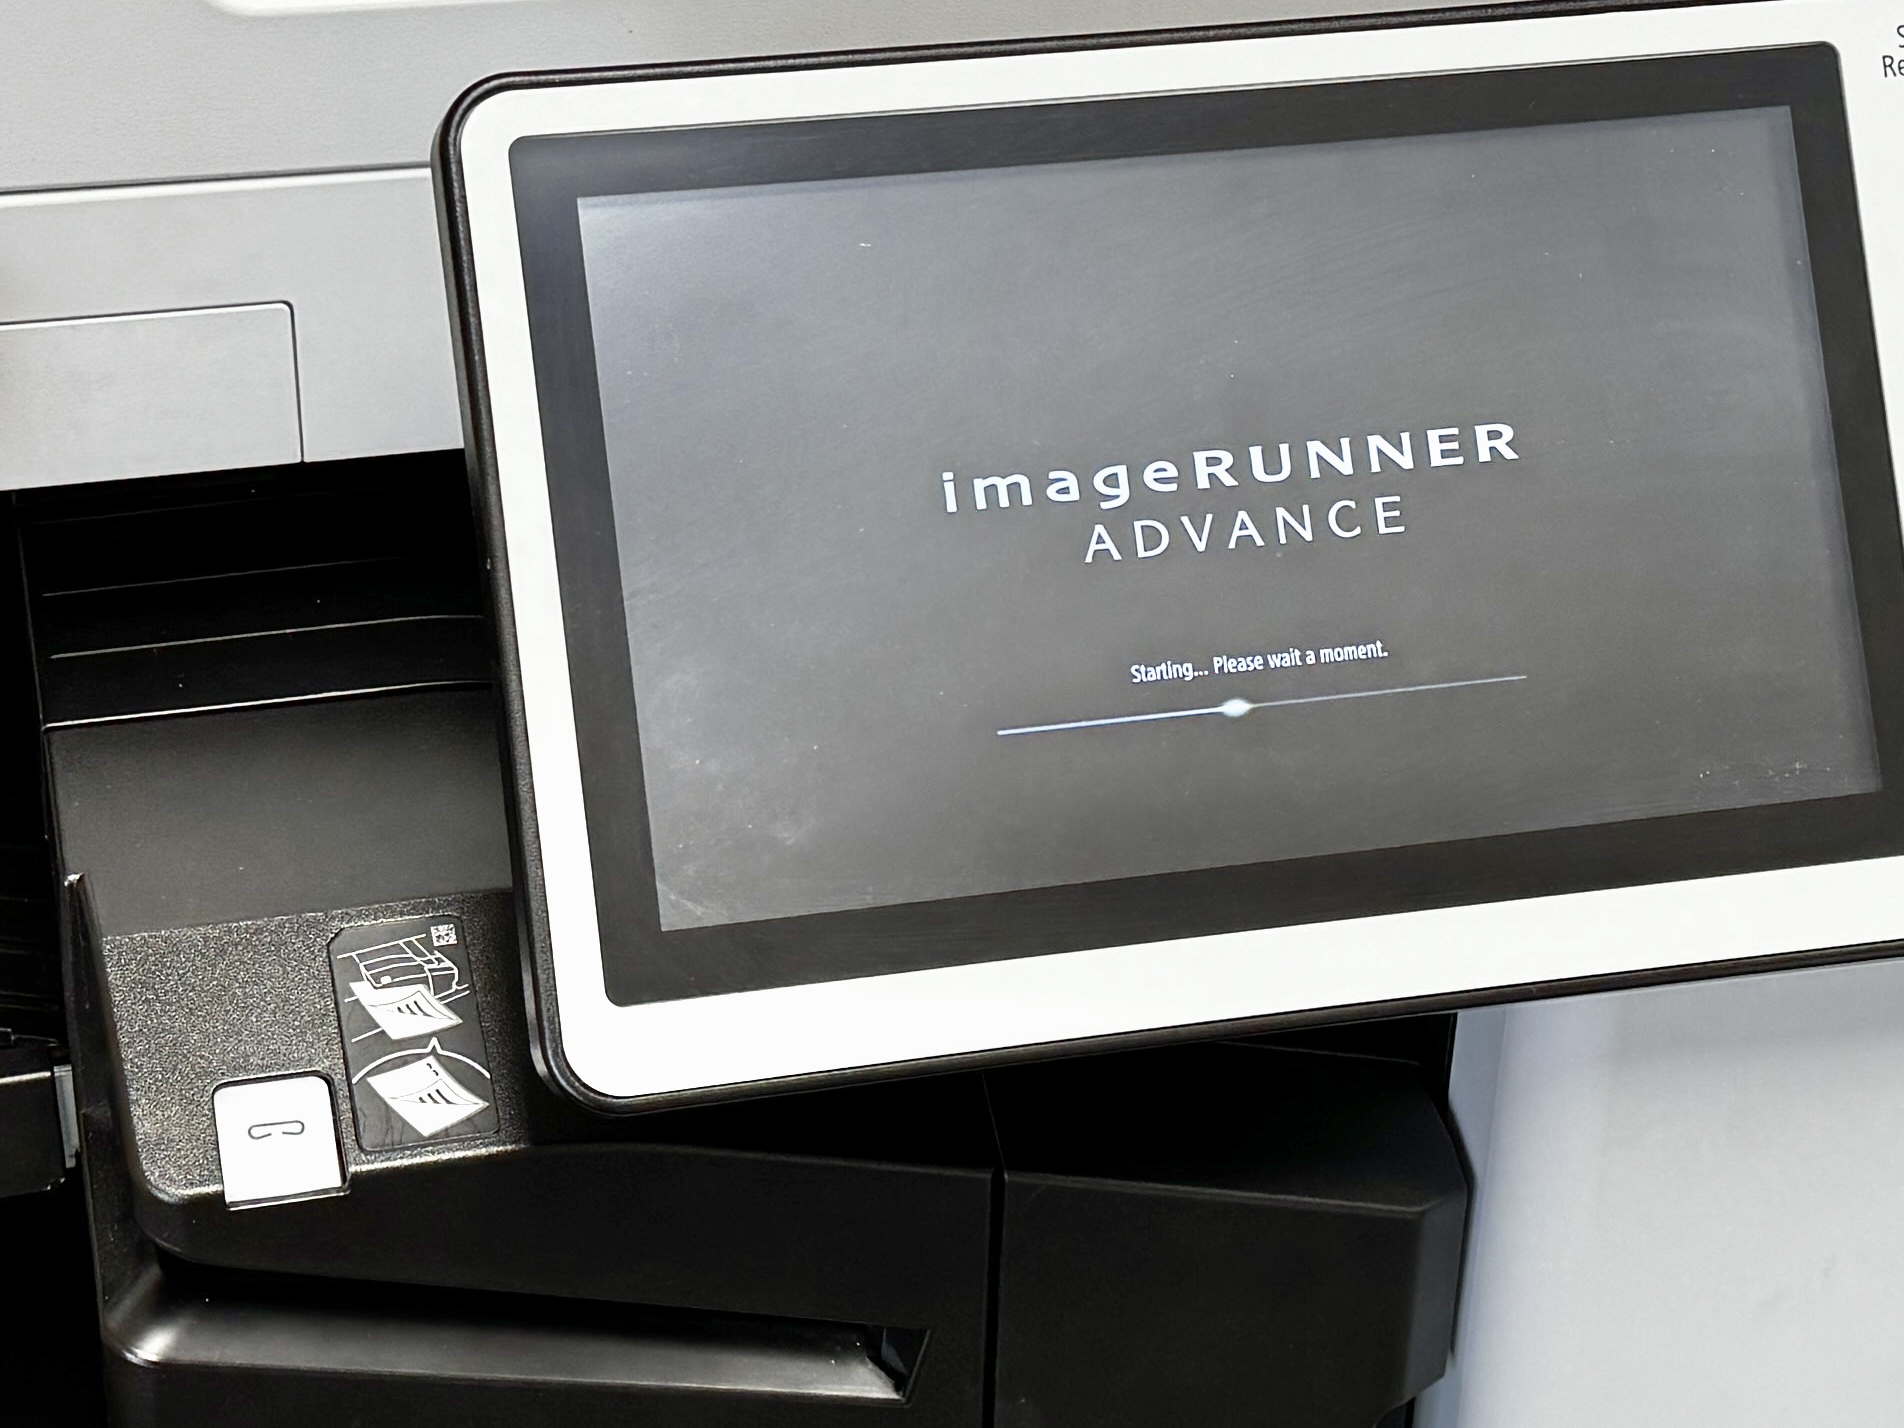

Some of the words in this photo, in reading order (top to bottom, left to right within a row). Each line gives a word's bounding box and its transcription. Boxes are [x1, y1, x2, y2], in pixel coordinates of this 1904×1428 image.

[941, 422, 1520, 514] imageRUNNER
[1084, 495, 1406, 563] ADVANCE
[1130, 660, 1209, 684] Starting...
[1213, 655, 1264, 675] Please
[1267, 648, 1302, 669] wait
[1305, 650, 1316, 665] a
[1319, 640, 1389, 664] moment.
